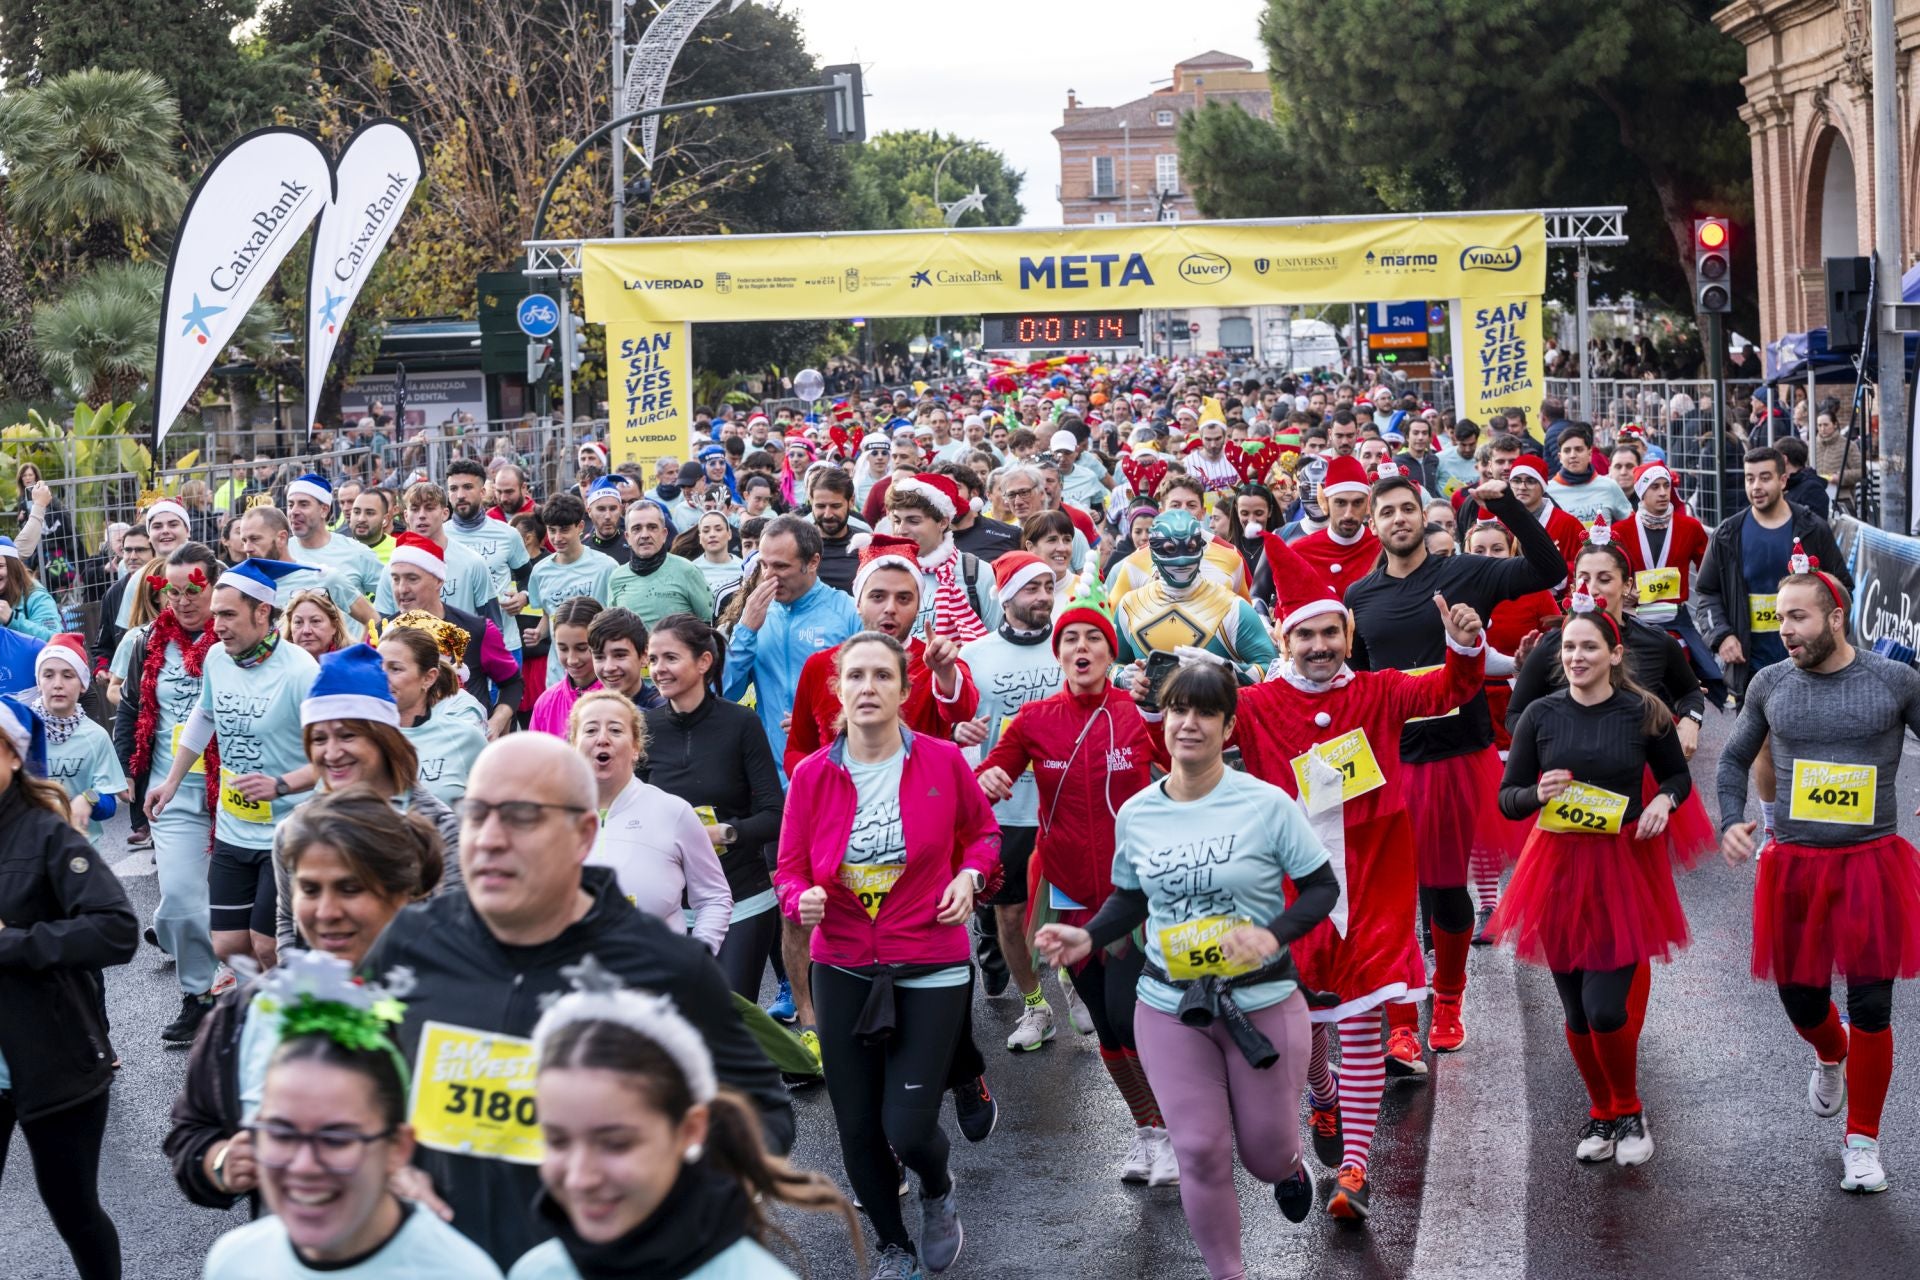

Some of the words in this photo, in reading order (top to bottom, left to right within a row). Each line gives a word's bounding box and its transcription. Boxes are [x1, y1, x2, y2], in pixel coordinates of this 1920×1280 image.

[210, 179, 307, 291] CaixaBank
[334, 171, 408, 282] CaixaBank
[1184, 263, 1226, 275] Juver
[1276, 256, 1338, 267] UNIVERSAE
[1381, 254, 1437, 267] marmo
[1468, 253, 1514, 265] VIDAL
[936, 270, 1003, 283] CaixaBank
[1019, 253, 1155, 290] META
[624, 280, 642, 290] LA
[645, 279, 704, 290] VERDAD
[1392, 316, 1414, 327] 24h
[1475, 301, 1528, 329] SAN
[1019, 317, 1123, 342] 0:01:14
[1484, 323, 1520, 348] SIL
[620, 331, 672, 359] SAN
[1479, 340, 1526, 367] VES
[628, 353, 665, 378] SIL
[1480, 360, 1528, 387] TRE
[420, 380, 467, 391] AVANZADA
[625, 370, 671, 397] VES
[1480, 378, 1532, 400] MURCIA
[413, 391, 449, 401] DENTAL
[625, 390, 673, 416] TRE
[626, 407, 678, 429] MURCIA
[626, 435, 638, 443] LA
[640, 433, 677, 443] VERDAD
[1648, 583, 1670, 593] 894
[992, 666, 1061, 695] SAN
[1121, 746, 1132, 756] DE
[1043, 760, 1069, 769] LOBIKA
[1803, 766, 1830, 777] SAN
[1801, 769, 1870, 789] SILVESTRE
[1807, 788, 1859, 807] 4021
[1555, 803, 1608, 831] 4022
[1147, 834, 1236, 879] SAN
[1170, 923, 1198, 945] SAN
[444, 1082, 539, 1128] 3180
